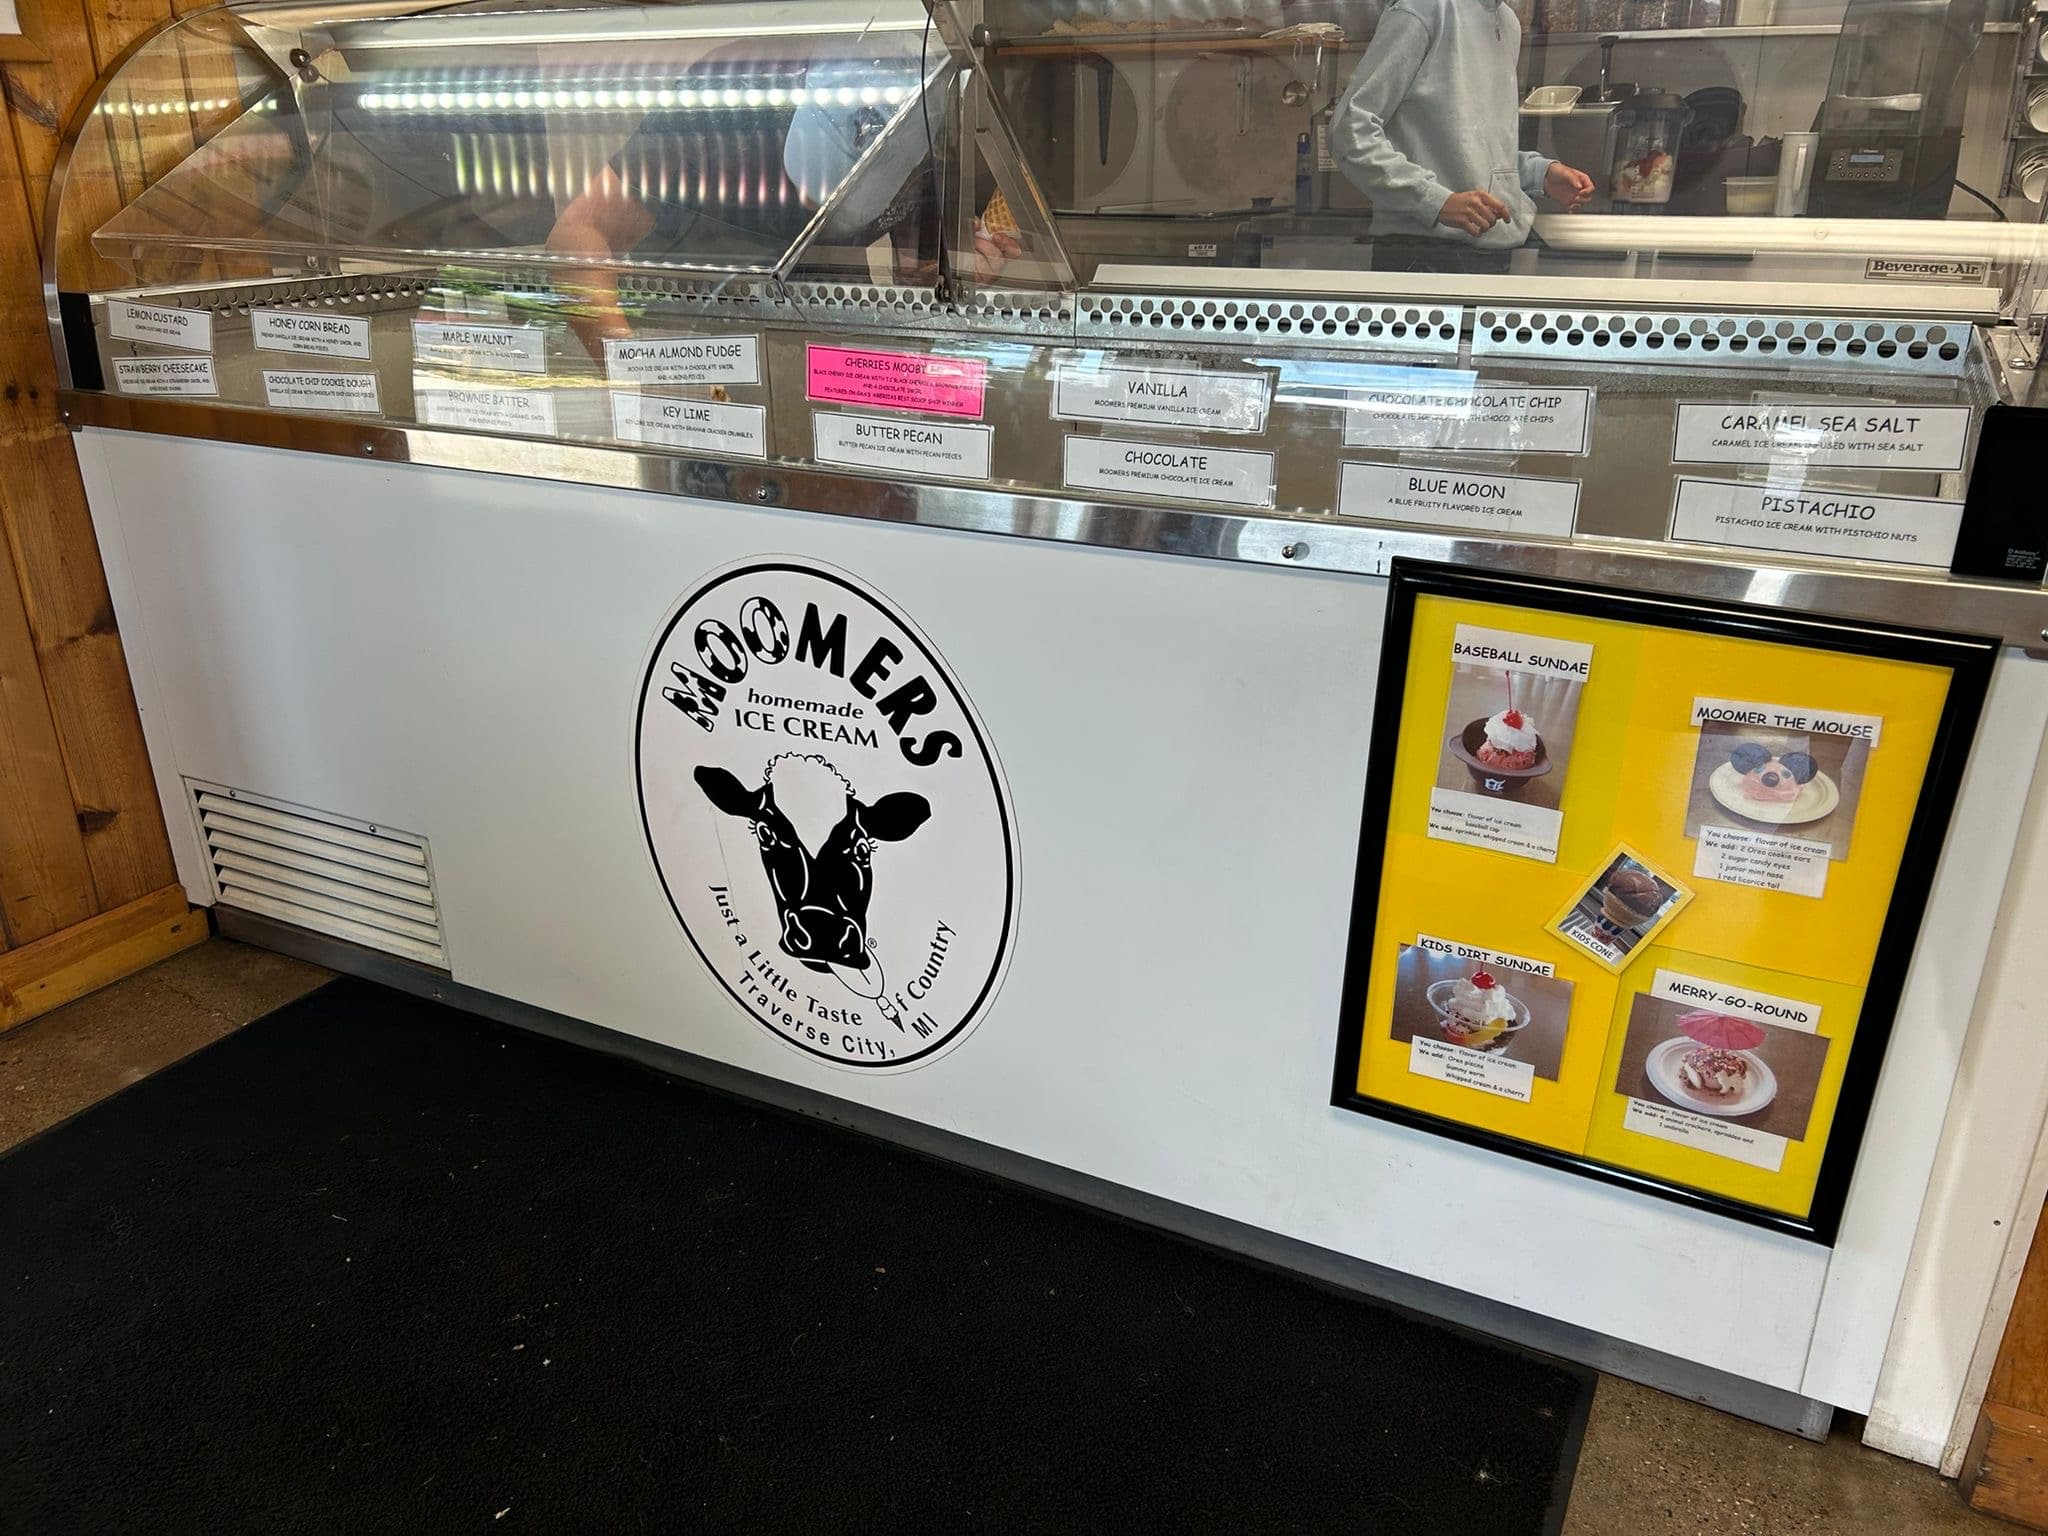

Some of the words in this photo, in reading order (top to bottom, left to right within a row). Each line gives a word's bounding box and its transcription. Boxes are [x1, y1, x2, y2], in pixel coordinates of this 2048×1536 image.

[127, 308, 152, 320] LEMON
[153, 313, 188, 326] CUSTARD
[269, 318, 296, 329] HONEY
[298, 321, 321, 331] CORN
[323, 322, 350, 334] BREAD
[443, 332, 470, 343] MAPLE
[473, 334, 513, 345] WALNUT
[619, 348, 656, 359] MOCHA
[659, 347, 703, 358] ALMOND
[706, 345, 741, 357] FUDGE
[119, 364, 161, 374] STRAWBERRY
[163, 363, 208, 373] CHEESECAKE
[845, 357, 891, 370] CHERRIES
[269, 376, 304, 385] CHOCOLATE
[321, 378, 345, 387] COOKIE
[347, 378, 371, 388] DOUGH
[1128, 382, 1188, 398] VANILLA
[448, 390, 490, 404] BROWNIE
[493, 396, 530, 407] BATTER
[1095, 400, 1125, 408] MOOMERS
[1127, 402, 1155, 411] PREMIUM
[1157, 404, 1185, 413] VANILLA
[1529, 397, 1562, 408] CHIP
[663, 406, 681, 417] KEY
[684, 408, 710, 421] LIME
[1820, 417, 1856, 432] SEA
[1864, 418, 1921, 433] SALT
[856, 424, 900, 440] BUTTER
[904, 429, 943, 445] PECAN
[839, 440, 858, 448] BUTTER
[859, 443, 876, 451] PECAN
[887, 446, 904, 454] CREAM
[923, 450, 941, 458] PECAN
[942, 452, 962, 460] PIECES
[1712, 439, 1752, 448] CARAMEL
[1754, 440, 1769, 448] ICE
[1848, 442, 1876, 450] WITH
[1877, 443, 1896, 451] SEA
[1898, 444, 1924, 452] SALT
[1125, 450, 1208, 470] CHOCOLATE
[1099, 468, 1130, 477] MOOMERS
[1131, 471, 1159, 480] PREMIUM
[1160, 474, 1198, 484] CHOCOLATE
[1199, 477, 1211, 485] ICE
[1212, 478, 1233, 487] CREAM
[1408, 478, 1448, 494] BLUE
[1452, 482, 1505, 499] MOON
[1395, 498, 1412, 506] BLUE
[1414, 500, 1441, 508] FRUITY
[1442, 503, 1480, 513] FLAVORED
[1482, 506, 1494, 514] ICE
[1497, 508, 1522, 516] CREAM
[1762, 496, 1876, 520] PISTACHIO
[1716, 516, 1764, 528] PISTACHIO
[1766, 520, 1782, 529] ICE
[1784, 522, 1813, 532] CREAM
[1816, 525, 1842, 535] WITH
[1842, 528, 1889, 540] PISTCHIO
[1890, 533, 1918, 542] NUTS
[1454, 643, 1523, 664] BASEBALL
[1528, 655, 1588, 674] SUNDAE
[662, 595, 964, 767] MOOMERS
[748, 688, 864, 719] homemade
[735, 709, 776, 732] ICE
[783, 717, 879, 749] CREAM
[1697, 707, 1767, 724] MOOMER
[1774, 715, 1806, 729] THE
[1812, 721, 1873, 737] MOUSE
[1483, 833, 1506, 843] whipped
[1536, 845, 1556, 855] cherry
[1707, 830, 1720, 838] You
[1723, 834, 1752, 842] choose:
[1755, 837, 1778, 846] flavor
[1790, 843, 1801, 851] ice
[1803, 846, 1827, 855] cream
[1721, 843, 1738, 851] add:
[1747, 847, 1766, 856] Oreo
[1768, 851, 1792, 859] cookie
[1725, 864, 1747, 872] junior
[1748, 867, 1765, 875] mint
[1728, 855, 1748, 864] sugar
[1750, 858, 1771, 868] candy
[1738, 876, 1765, 886] licorice
[1571, 930, 1591, 944] KIDS
[1590, 942, 1614, 959] CONE
[709, 885, 740, 926] Just
[735, 933, 748, 947] a
[748, 950, 798, 1002] Little
[806, 995, 863, 1026] Taste
[907, 920, 957, 1000] Country
[1421, 938, 1452, 953] KIDS
[1457, 947, 1490, 961] DIRT
[1495, 956, 1551, 976] SUNDAE
[1669, 982, 1808, 1023] MERRY-GO-ROUND
[737, 970, 831, 1045] Traverse
[841, 1035, 896, 1060] City,
[911, 1012, 939, 1039] MI
[1446, 1064, 1467, 1074] Gummy
[1464, 1060, 1484, 1069] pieces
[1497, 1060, 1517, 1068] cream
[1445, 1072, 1472, 1084] Whipped
[1473, 1079, 1491, 1088] cream
[1504, 1088, 1525, 1098] cherry
